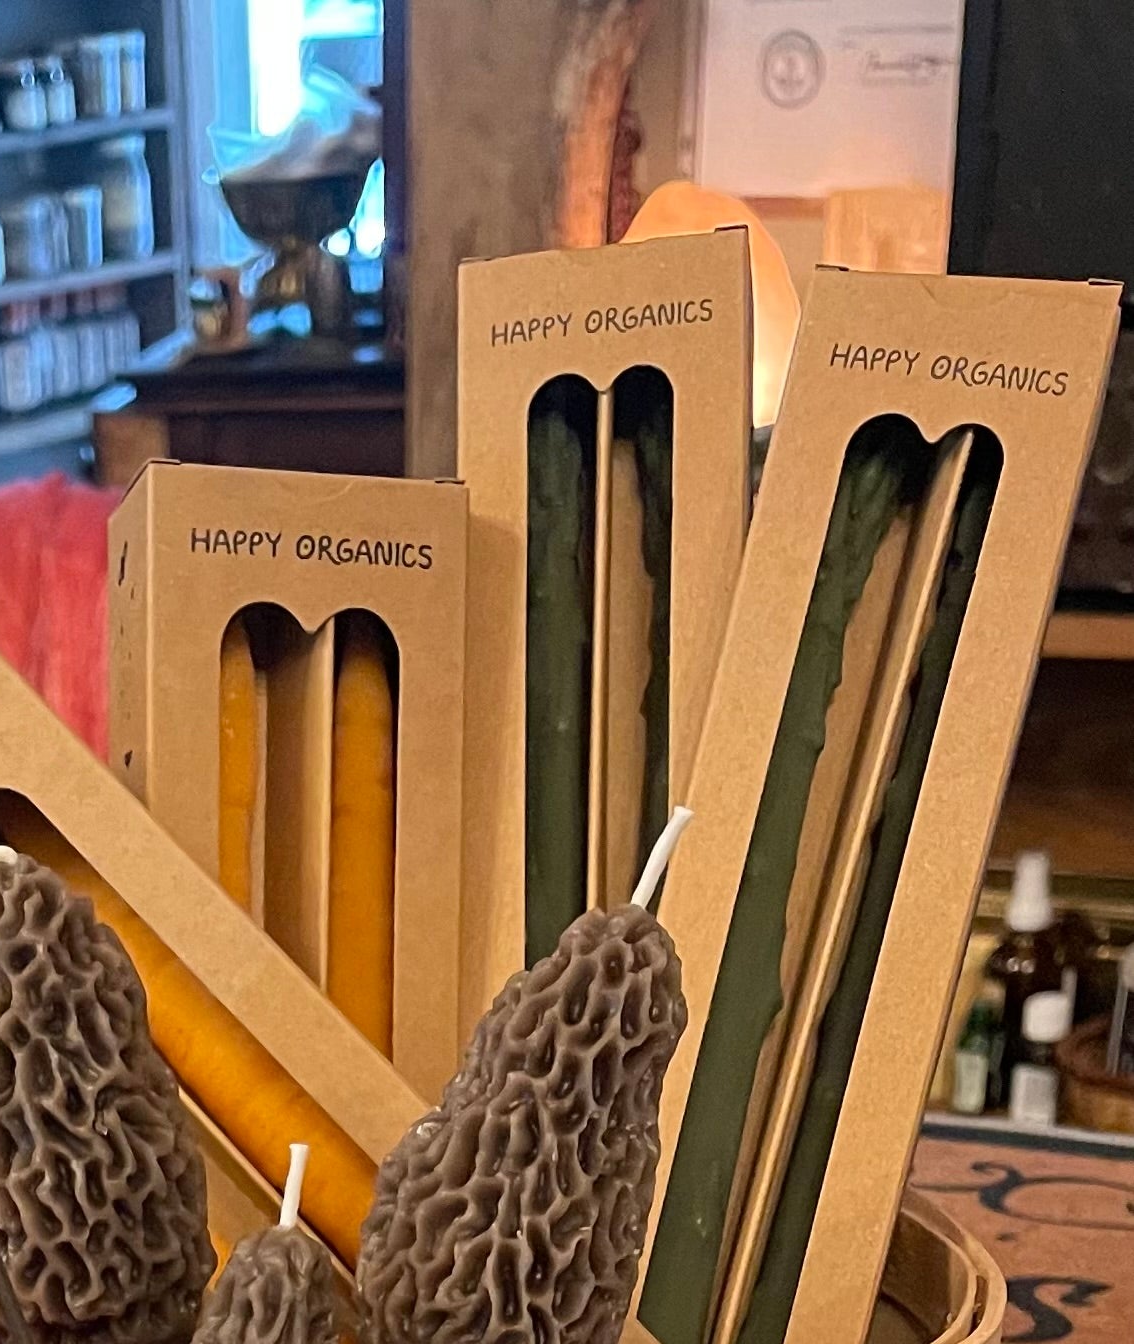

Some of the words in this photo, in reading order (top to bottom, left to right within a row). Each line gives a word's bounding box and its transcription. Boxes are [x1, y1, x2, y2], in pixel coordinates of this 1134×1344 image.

[490, 311, 573, 348] HAPPY
[583, 297, 714, 335] ORGANICS
[829, 343, 921, 377] HAPPY
[929, 354, 1069, 397] ORGANICS
[190, 527, 283, 558] HAPPY
[294, 534, 434, 571] ORGANICS
